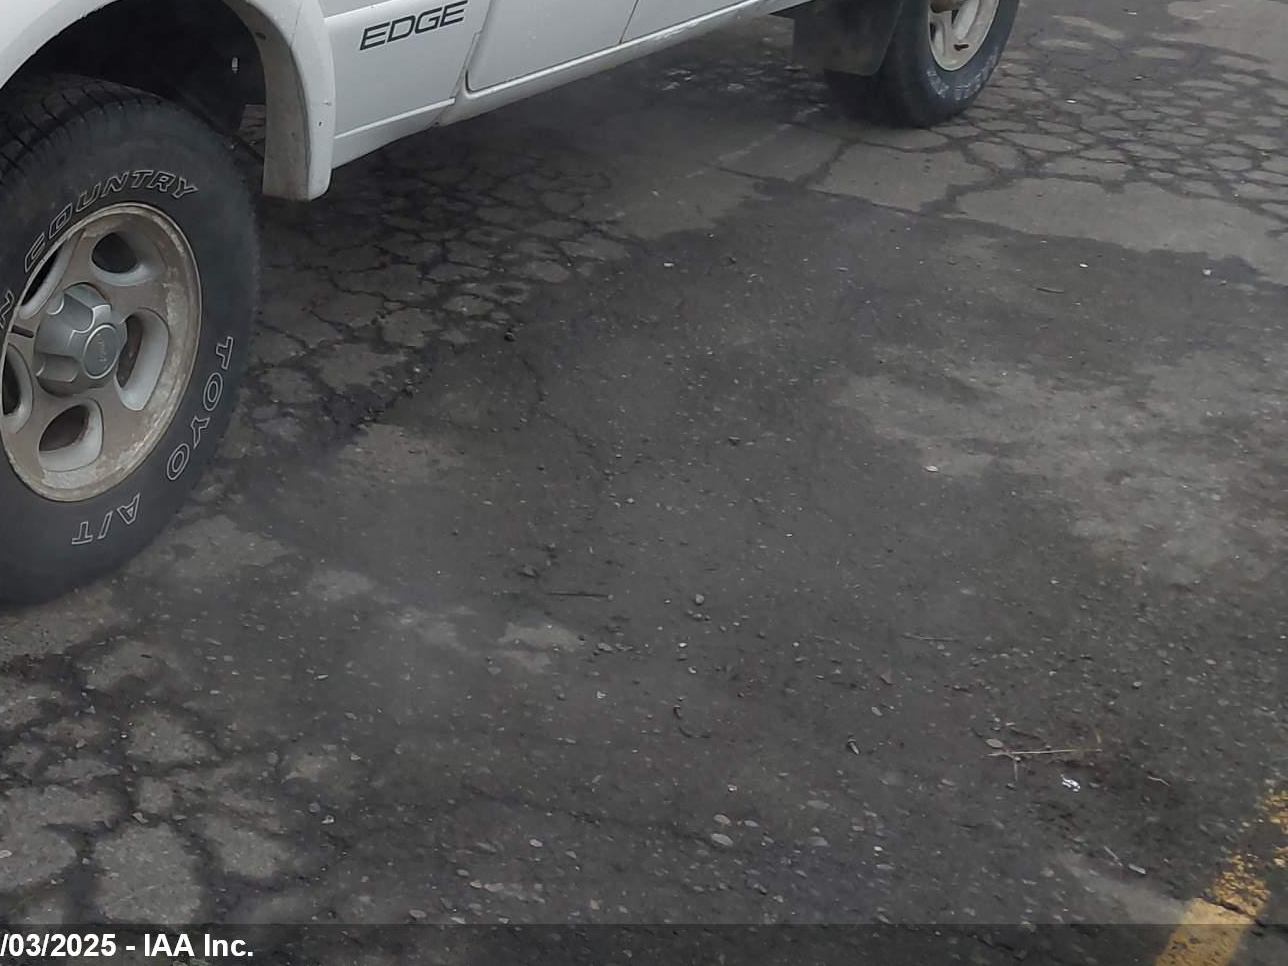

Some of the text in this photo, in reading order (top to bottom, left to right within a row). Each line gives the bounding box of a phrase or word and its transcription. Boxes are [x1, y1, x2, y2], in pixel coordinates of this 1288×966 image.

[359, 0, 469, 51] EDGE
[24, 169, 199, 273] COUNTRY
[71, 336, 234, 545] TOYO A/T
